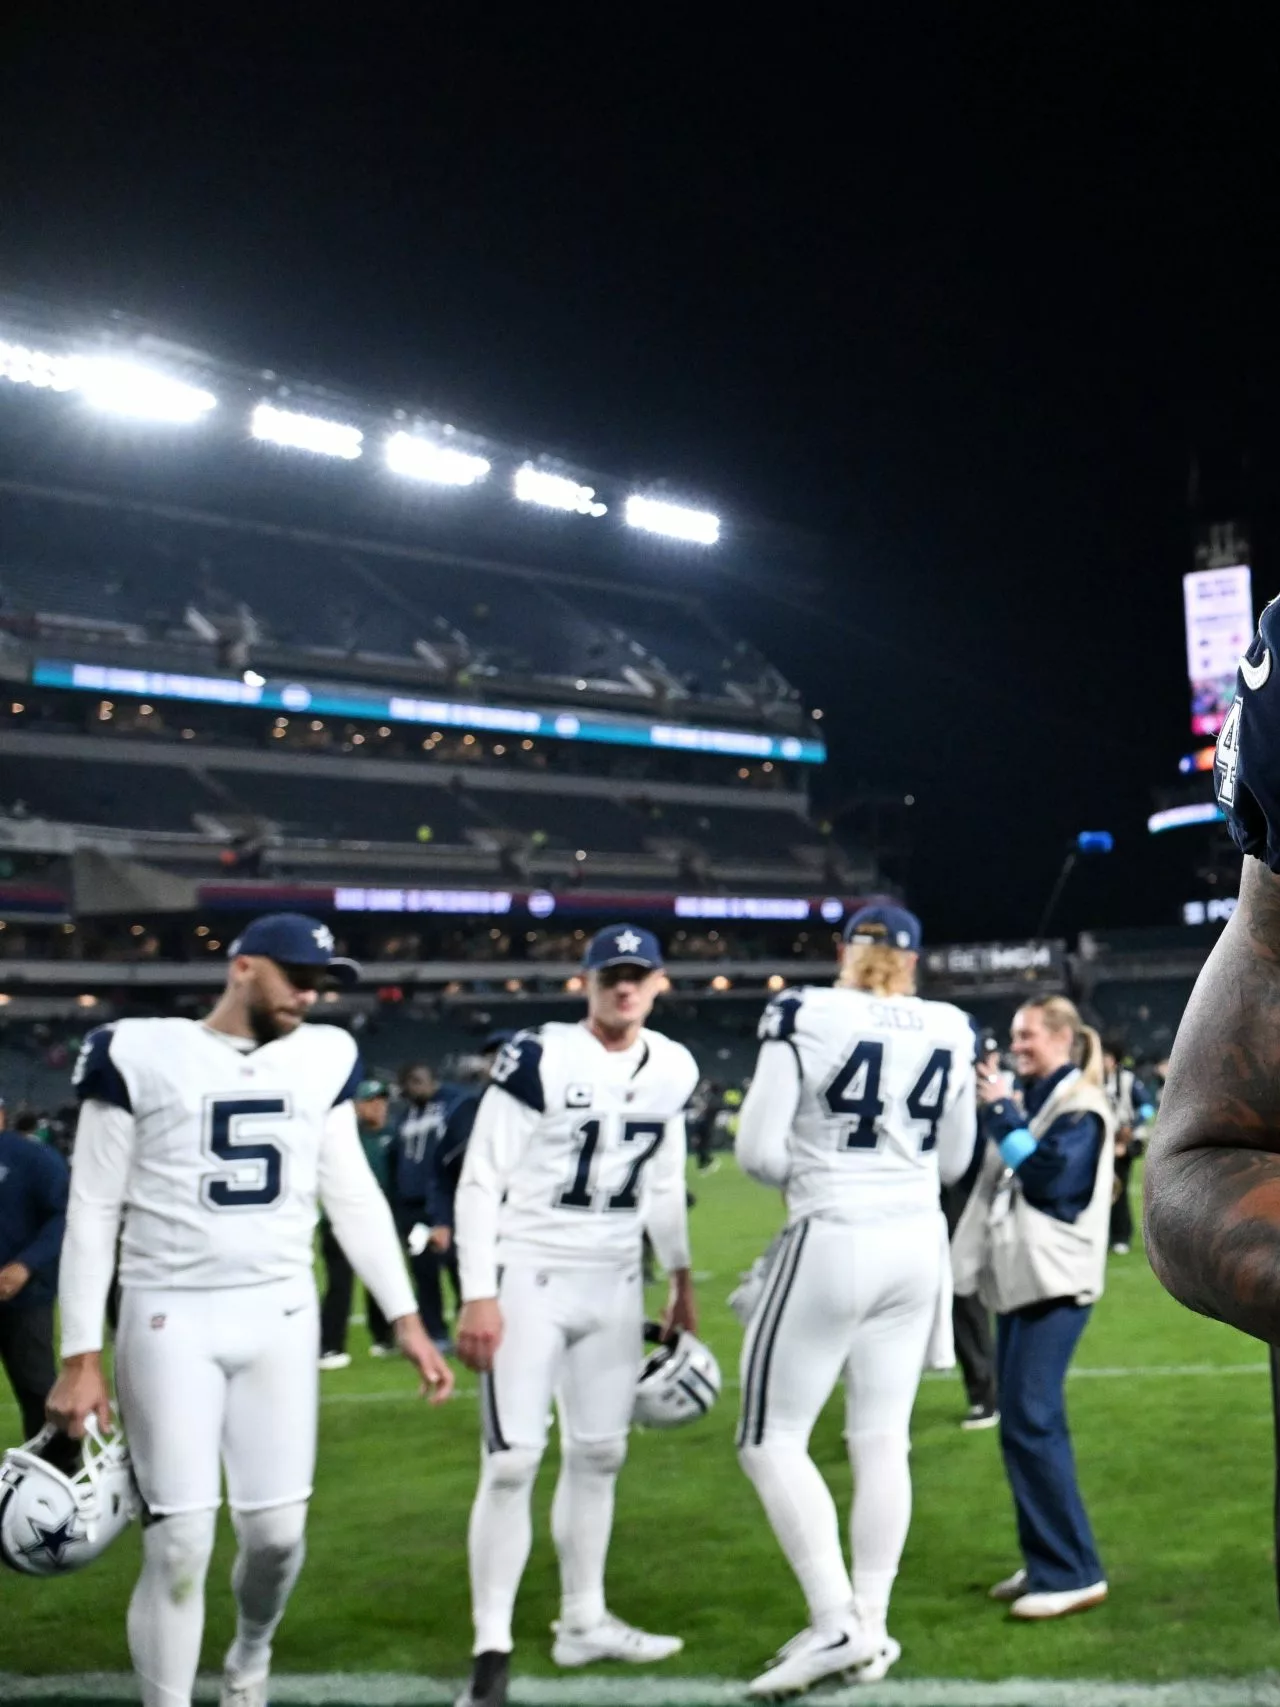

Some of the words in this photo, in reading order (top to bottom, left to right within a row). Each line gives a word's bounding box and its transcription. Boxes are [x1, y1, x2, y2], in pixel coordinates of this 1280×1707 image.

[1215, 695, 1243, 808] 4
[819, 1035, 952, 1153] 44
[200, 1092, 292, 1212] 5
[553, 1114, 668, 1211] 17
